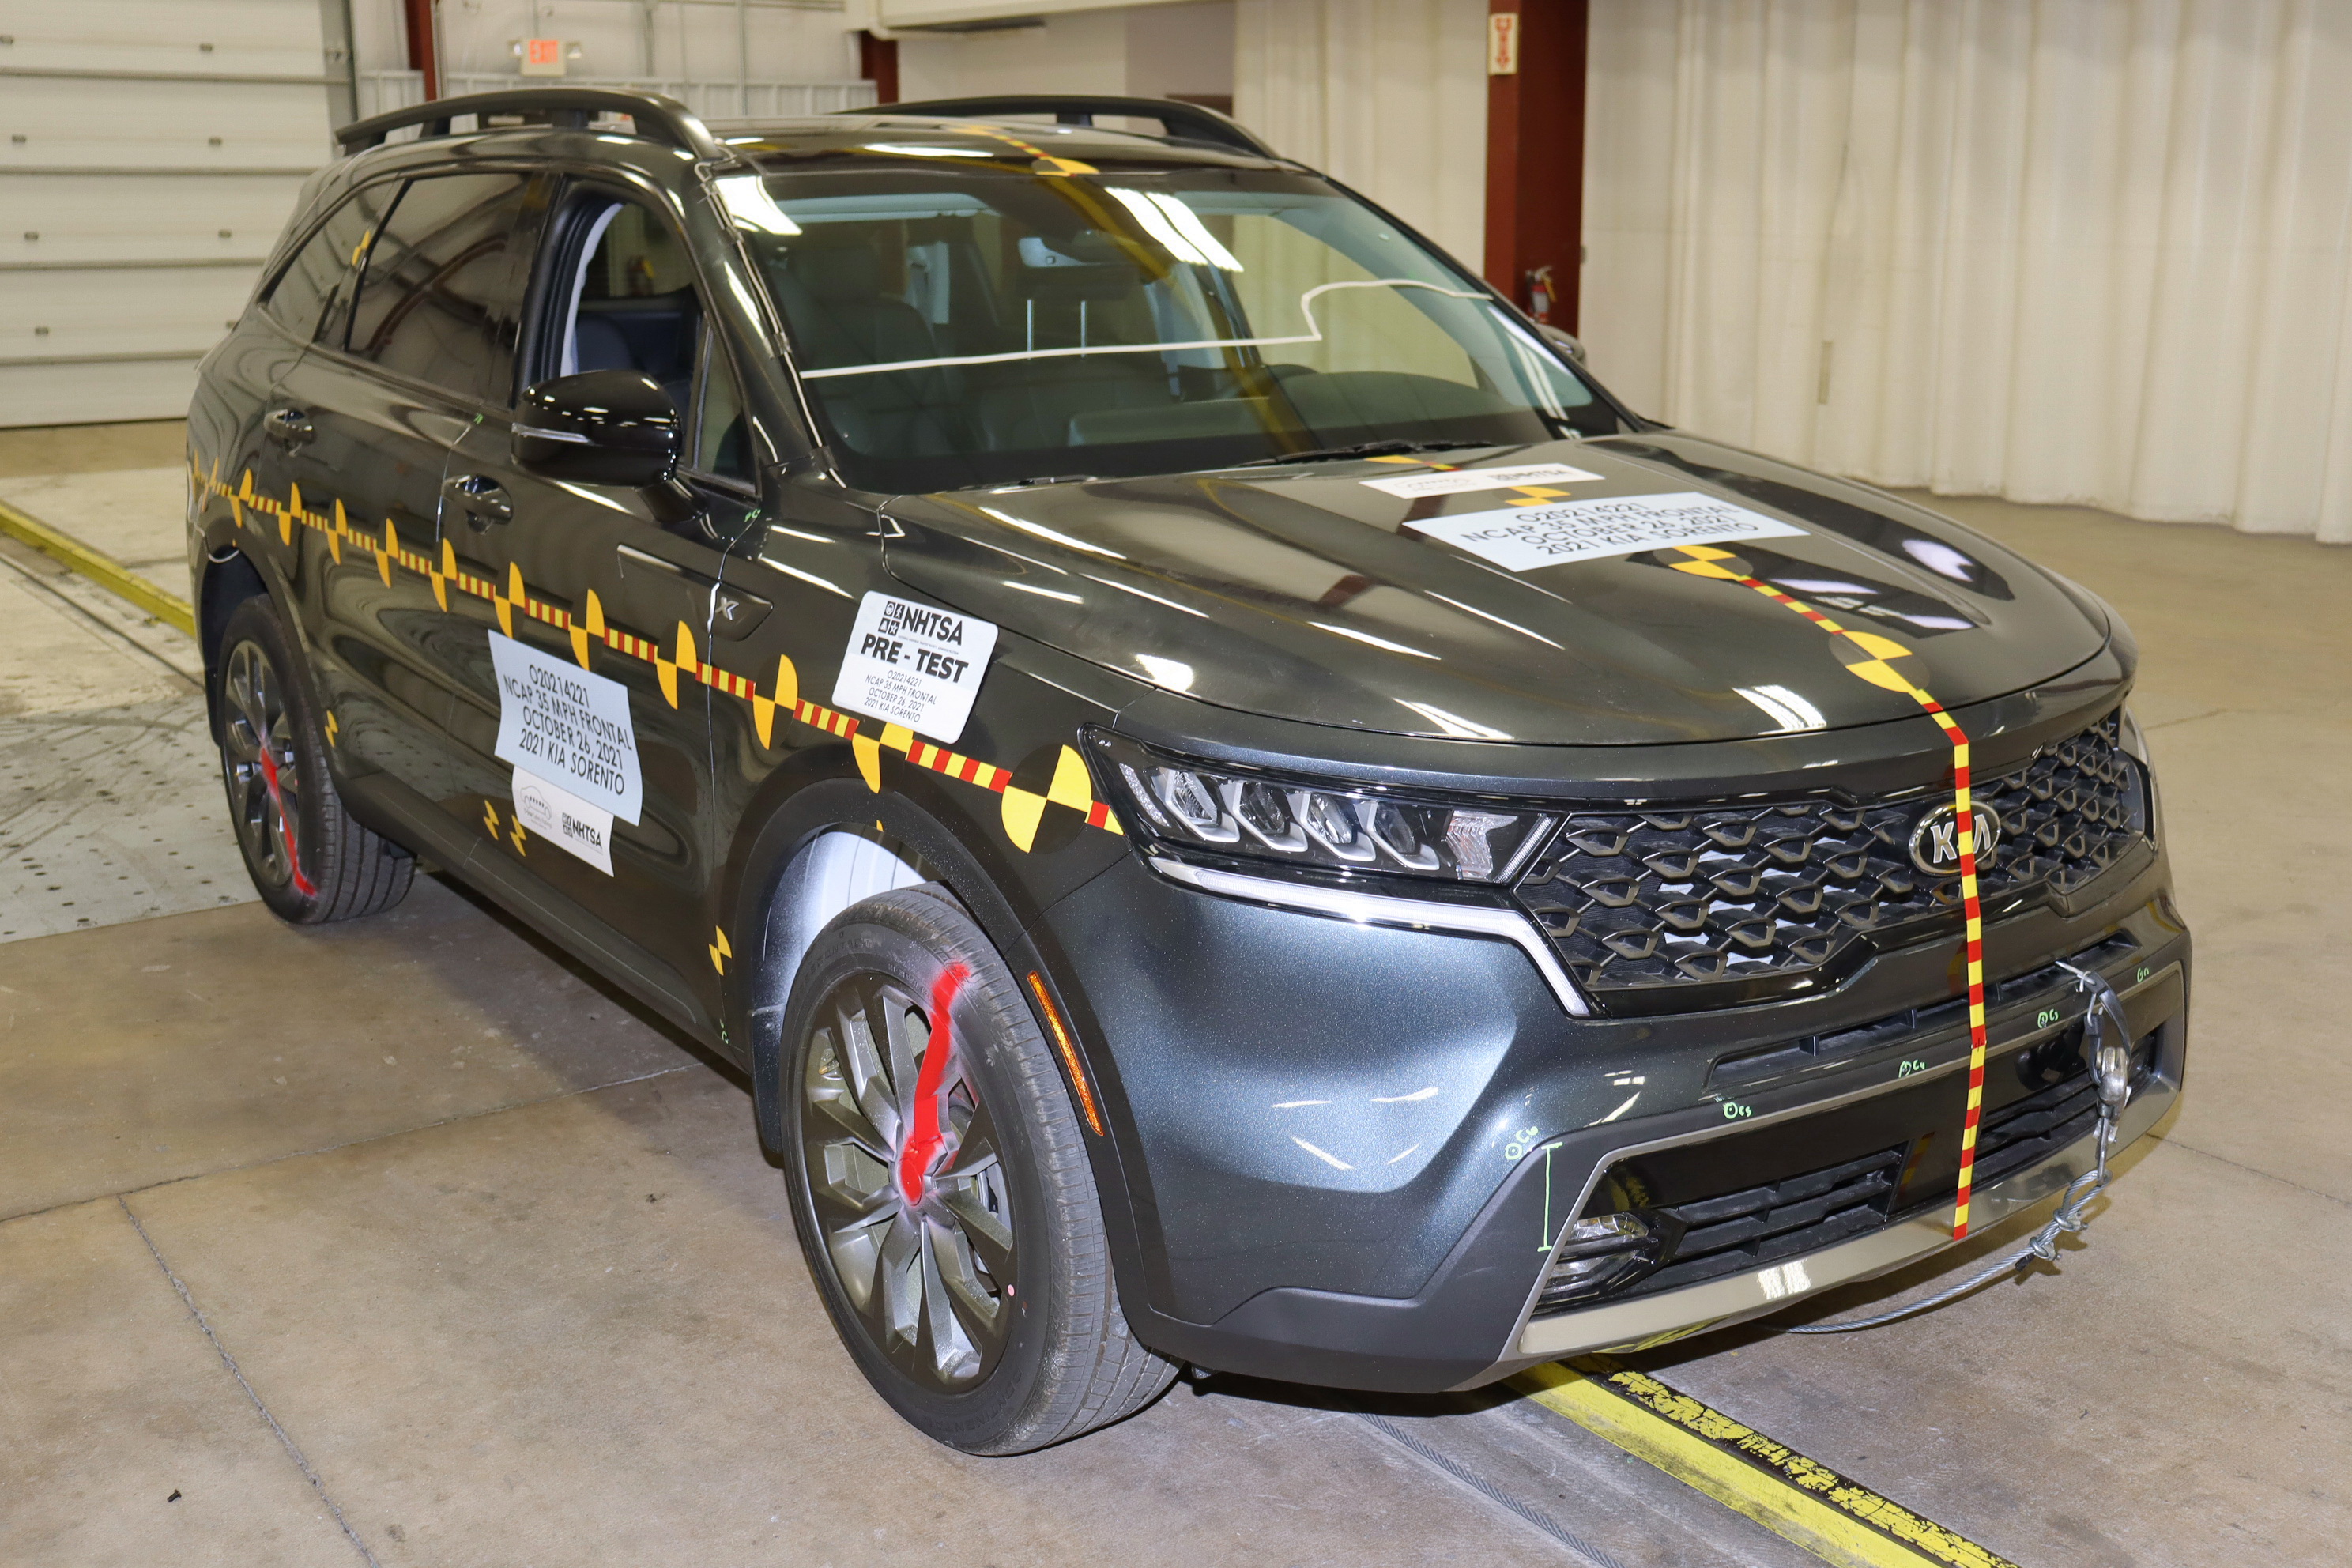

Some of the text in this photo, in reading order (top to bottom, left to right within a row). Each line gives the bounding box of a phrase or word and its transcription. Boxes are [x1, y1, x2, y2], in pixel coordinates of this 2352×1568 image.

[1461, 505, 1741, 542] NCAP 35 MPH FRONTAL
[1521, 522, 1645, 545] OCTOBER
[1680, 514, 1737, 525] 2021
[1536, 522, 1758, 555] 2021 KIA SORENTO
[902, 606, 963, 646] NHTSA
[861, 634, 903, 664] PRE
[916, 648, 969, 683] TEST
[865, 675, 937, 705] NCAP 35 MPH FRONTAL
[869, 687, 898, 703] OCTOBER
[909, 699, 924, 710] 2021
[503, 676, 632, 750] NCAP 35 MPH FRONTAL
[864, 697, 921, 722] 2021 KIA SORENTO
[523, 707, 573, 746] OCTOBER
[597, 740, 624, 769] 2021
[519, 729, 624, 795] 2021 KIA SORENTO
[572, 820, 602, 849] NHTSA
[1930, 813, 1991, 864] KA
